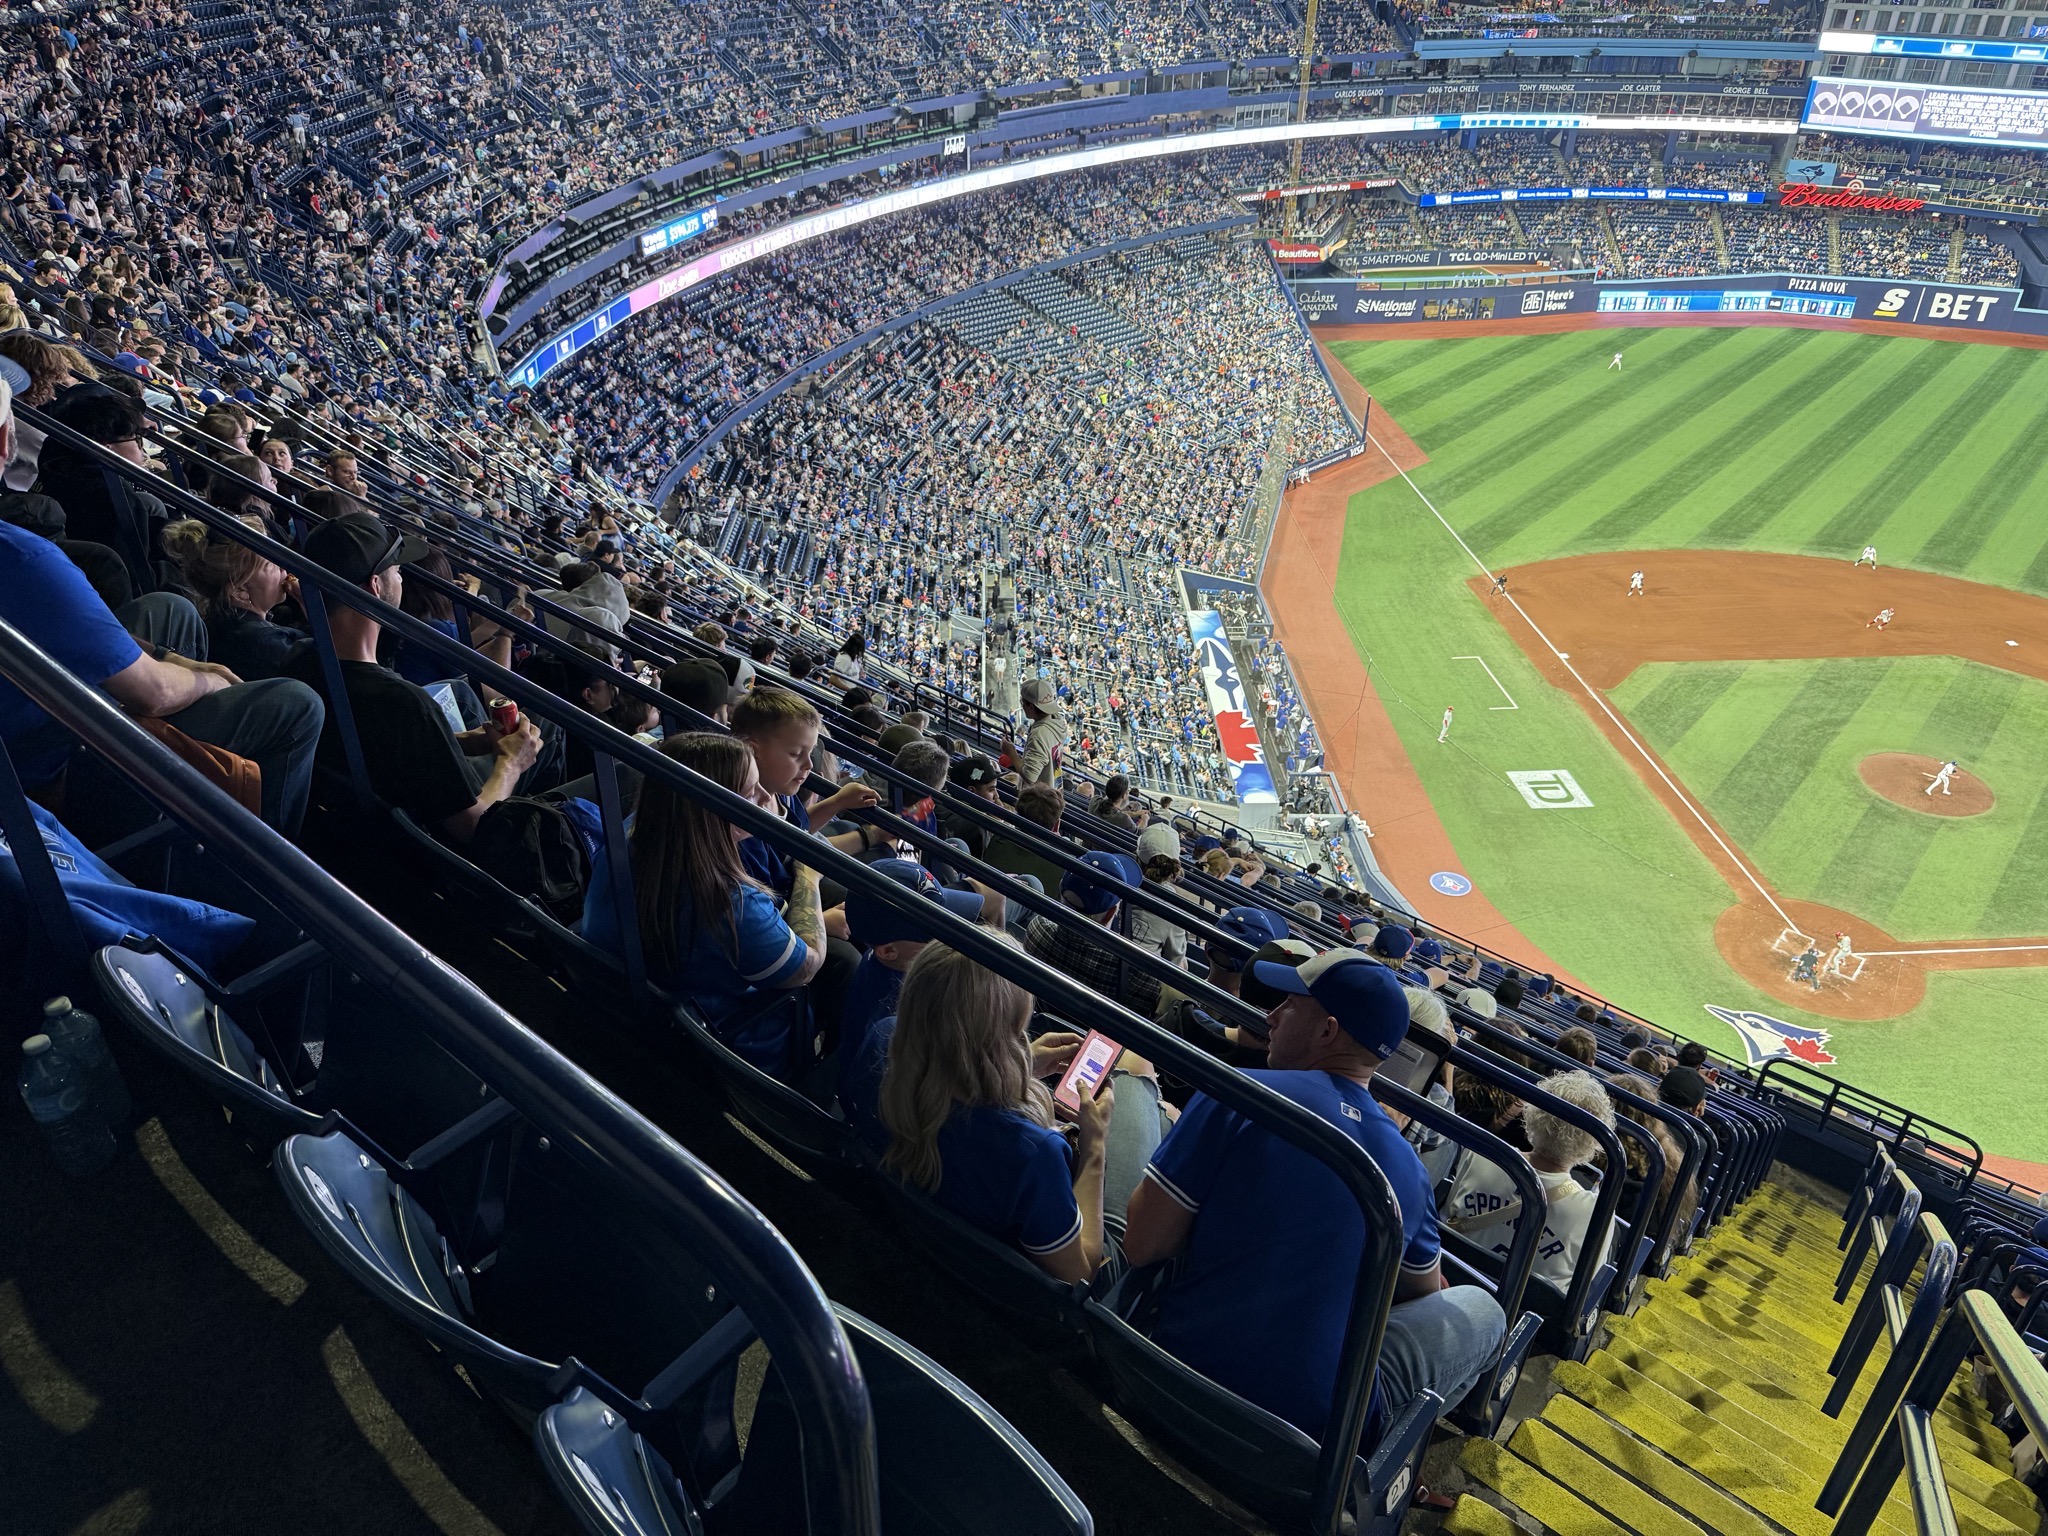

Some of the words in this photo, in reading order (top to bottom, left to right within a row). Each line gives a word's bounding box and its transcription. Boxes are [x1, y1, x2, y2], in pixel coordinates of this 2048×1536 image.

[1357, 89, 1384, 97] DELGADO
[1427, 86, 1442, 94] 4306
[1443, 85, 1458, 93] TOM
[1620, 84, 1634, 92] JOE
[1635, 84, 1661, 92] CARTER
[1723, 86, 1751, 94] GEORGE
[1753, 87, 1769, 95] BELL
[1647, 190, 1666, 198] VISA
[1728, 192, 1748, 202] VISA
[1778, 182, 1925, 212] Budweiser
[720, 243, 752, 268] KNOCK
[1361, 252, 1430, 266] SMARTPHONE
[1450, 252, 1471, 262] TCL
[1788, 278, 1817, 291] PIZZA
[1819, 280, 1847, 294] NOVA
[1300, 293, 1336, 302] CLEARLY
[1545, 289, 1574, 300] Here's
[1296, 301, 1338, 312] CANADIAN
[1544, 301, 1566, 312] How.
[1928, 292, 2000, 322] BET
[1526, 774, 1574, 803] TD
[1502, 1371, 1514, 1393] 20
[1390, 1474, 1406, 1506] 21
